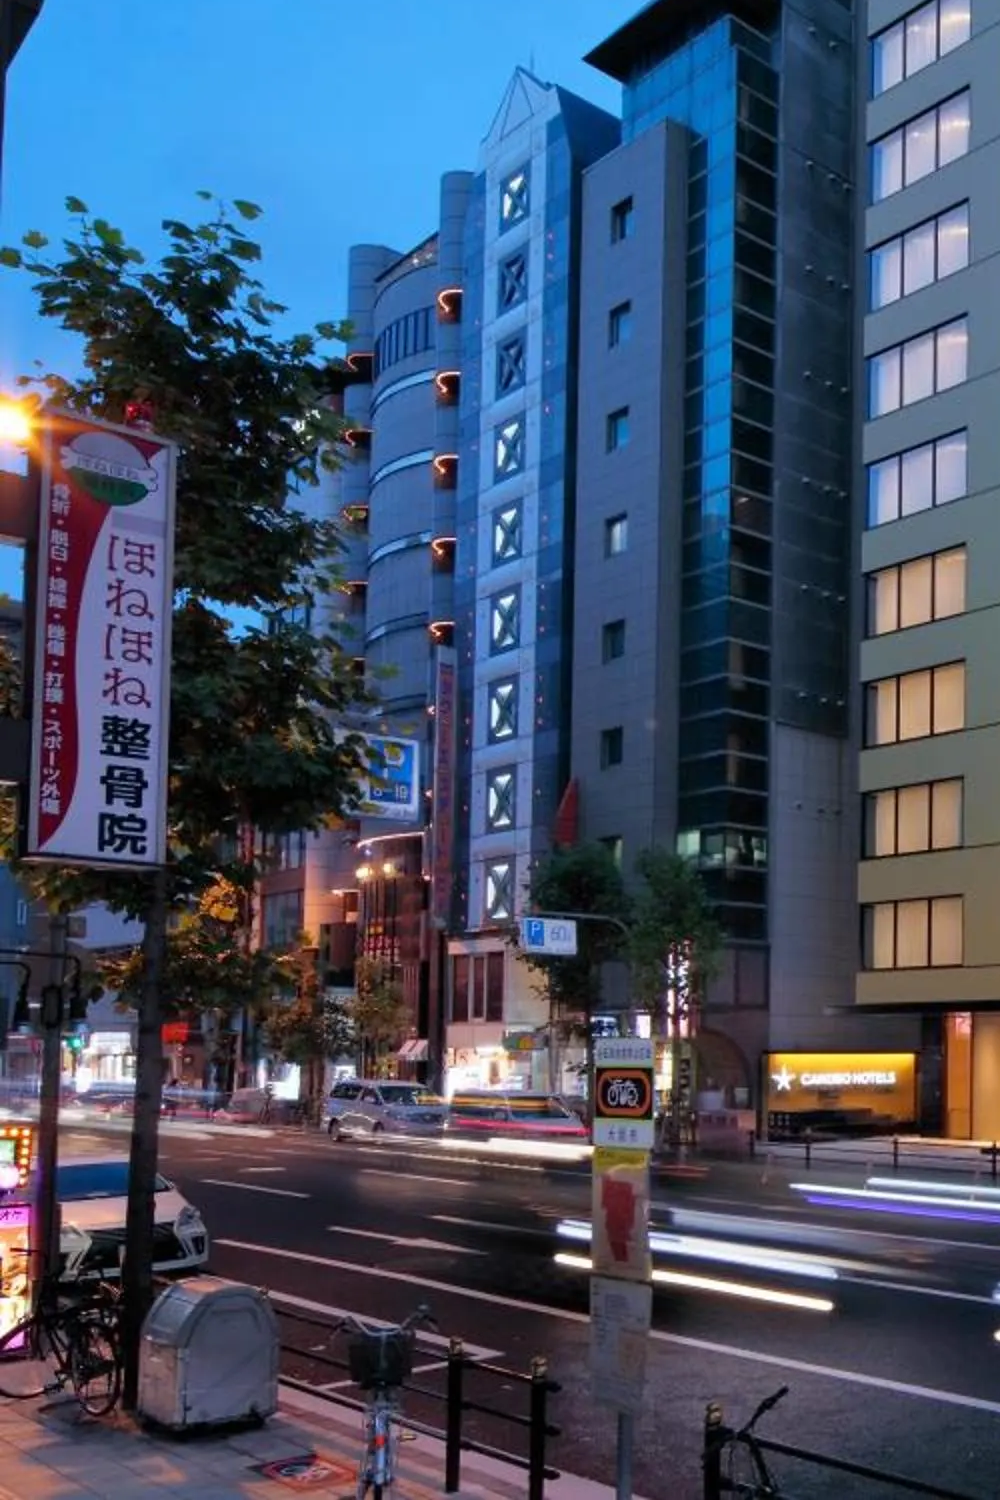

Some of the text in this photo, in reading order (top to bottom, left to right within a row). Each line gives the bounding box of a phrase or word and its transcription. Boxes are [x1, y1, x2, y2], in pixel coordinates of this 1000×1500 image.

[97, 534, 156, 854] ほねほね整骨院
[531, 921, 541, 937] P
